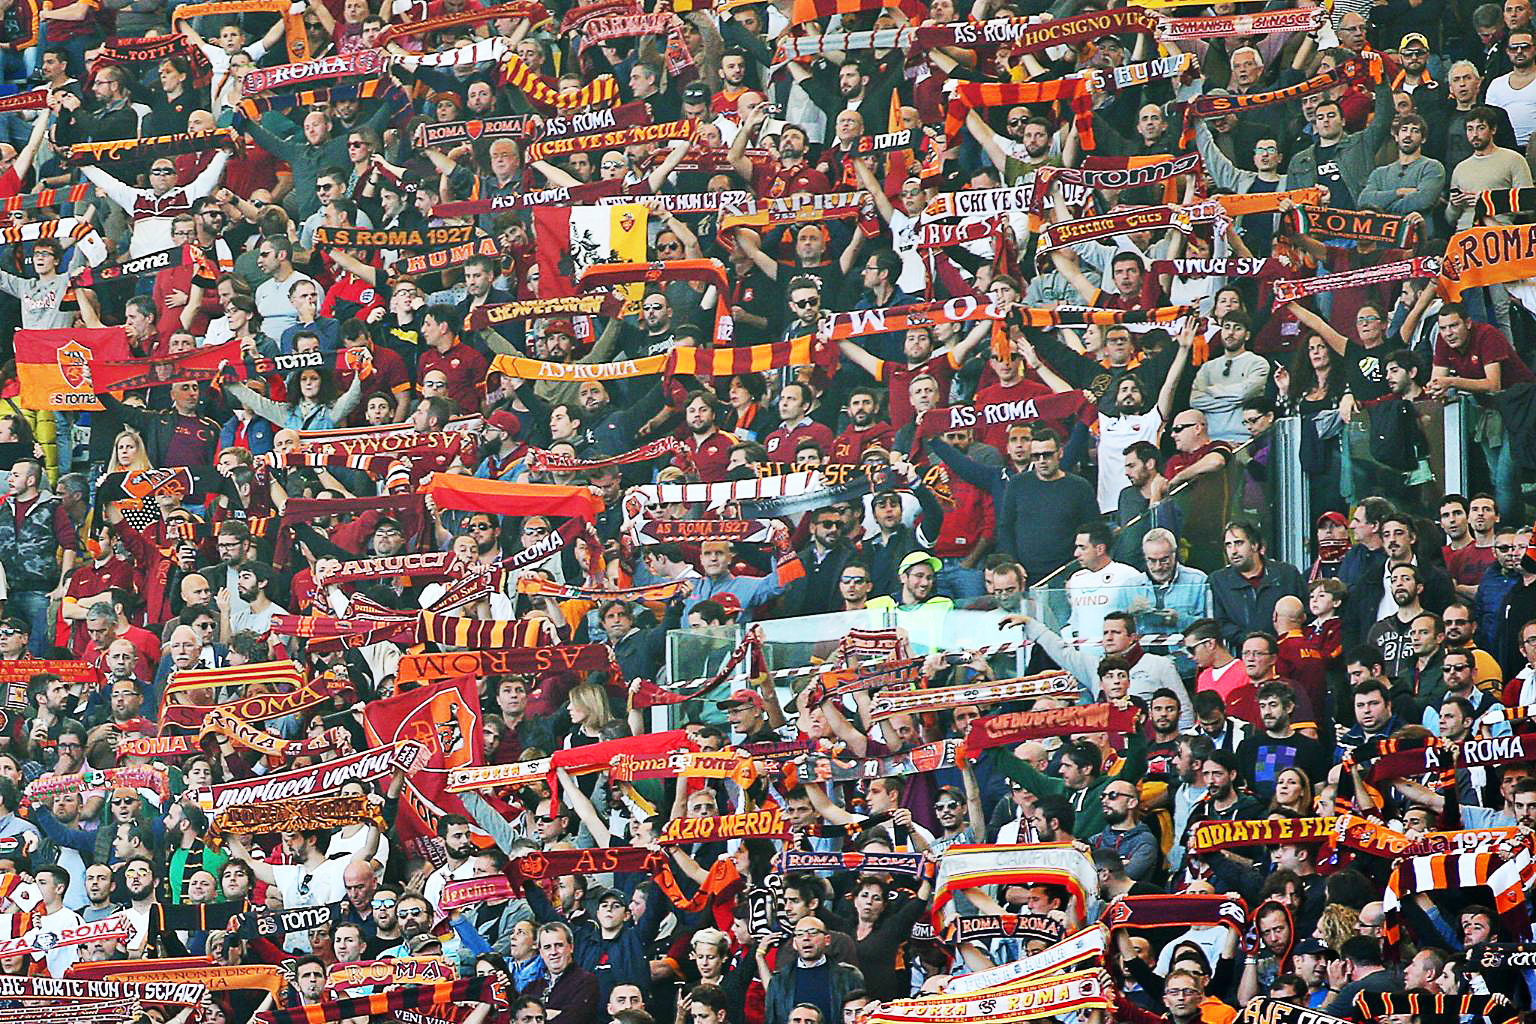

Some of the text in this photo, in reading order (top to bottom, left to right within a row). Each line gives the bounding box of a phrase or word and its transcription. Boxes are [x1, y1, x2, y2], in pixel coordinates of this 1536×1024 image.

[1026, 23, 1058, 46] HOC
[1059, 15, 1109, 40] SIGNO
[273, 56, 348, 84] ROMA
[1116, 55, 1191, 86] ROMA
[1236, 71, 1332, 106] roma
[429, 119, 522, 141] ROMA ROMA
[875, 131, 912, 150] roma
[541, 136, 570, 156] CHI
[577, 134, 599, 151] VE
[605, 130, 626, 148] SE
[1082, 153, 1198, 188] roma
[960, 193, 987, 214] CHI
[991, 191, 1012, 213] VE
[1015, 188, 1033, 209] SE
[317, 225, 472, 246] A.S. ROMA 1927
[1309, 212, 1398, 238] ROMA
[406, 238, 498, 273] ROMA
[1461, 226, 1536, 270] ROMA
[122, 251, 170, 275] roma
[275, 350, 324, 371] roma
[65, 393, 96, 405] roma
[656, 521, 749, 535] AS ROMA 1927
[513, 532, 564, 565] ROMA
[330, 552, 449, 577] PANUCCI
[538, 648, 582, 670] AS
[226, 685, 323, 721] ROMA
[210, 711, 276, 751] ROMA
[124, 735, 187, 755] ROMA
[1463, 736, 1525, 764] ROMA
[215, 751, 392, 809] mortacci vostra
[717, 809, 785, 838] MERDA
[1196, 819, 1294, 849] ODIATI E
[1454, 832, 1506, 850] 1927
[573, 849, 619, 872] AS
[789, 854, 917, 868] ROMA ROMA
[61, 919, 124, 940] ROMA
[280, 906, 332, 930] roma
[961, 917, 1059, 935] ROMA ROMA
[345, 960, 442, 983] ROMA
[33, 979, 84, 997] MORTE
[88, 980, 119, 997] NON
[123, 981, 140, 998] CI
[901, 987, 1072, 1018] FORZA ROMA
[394, 1010, 424, 1024] VENI
